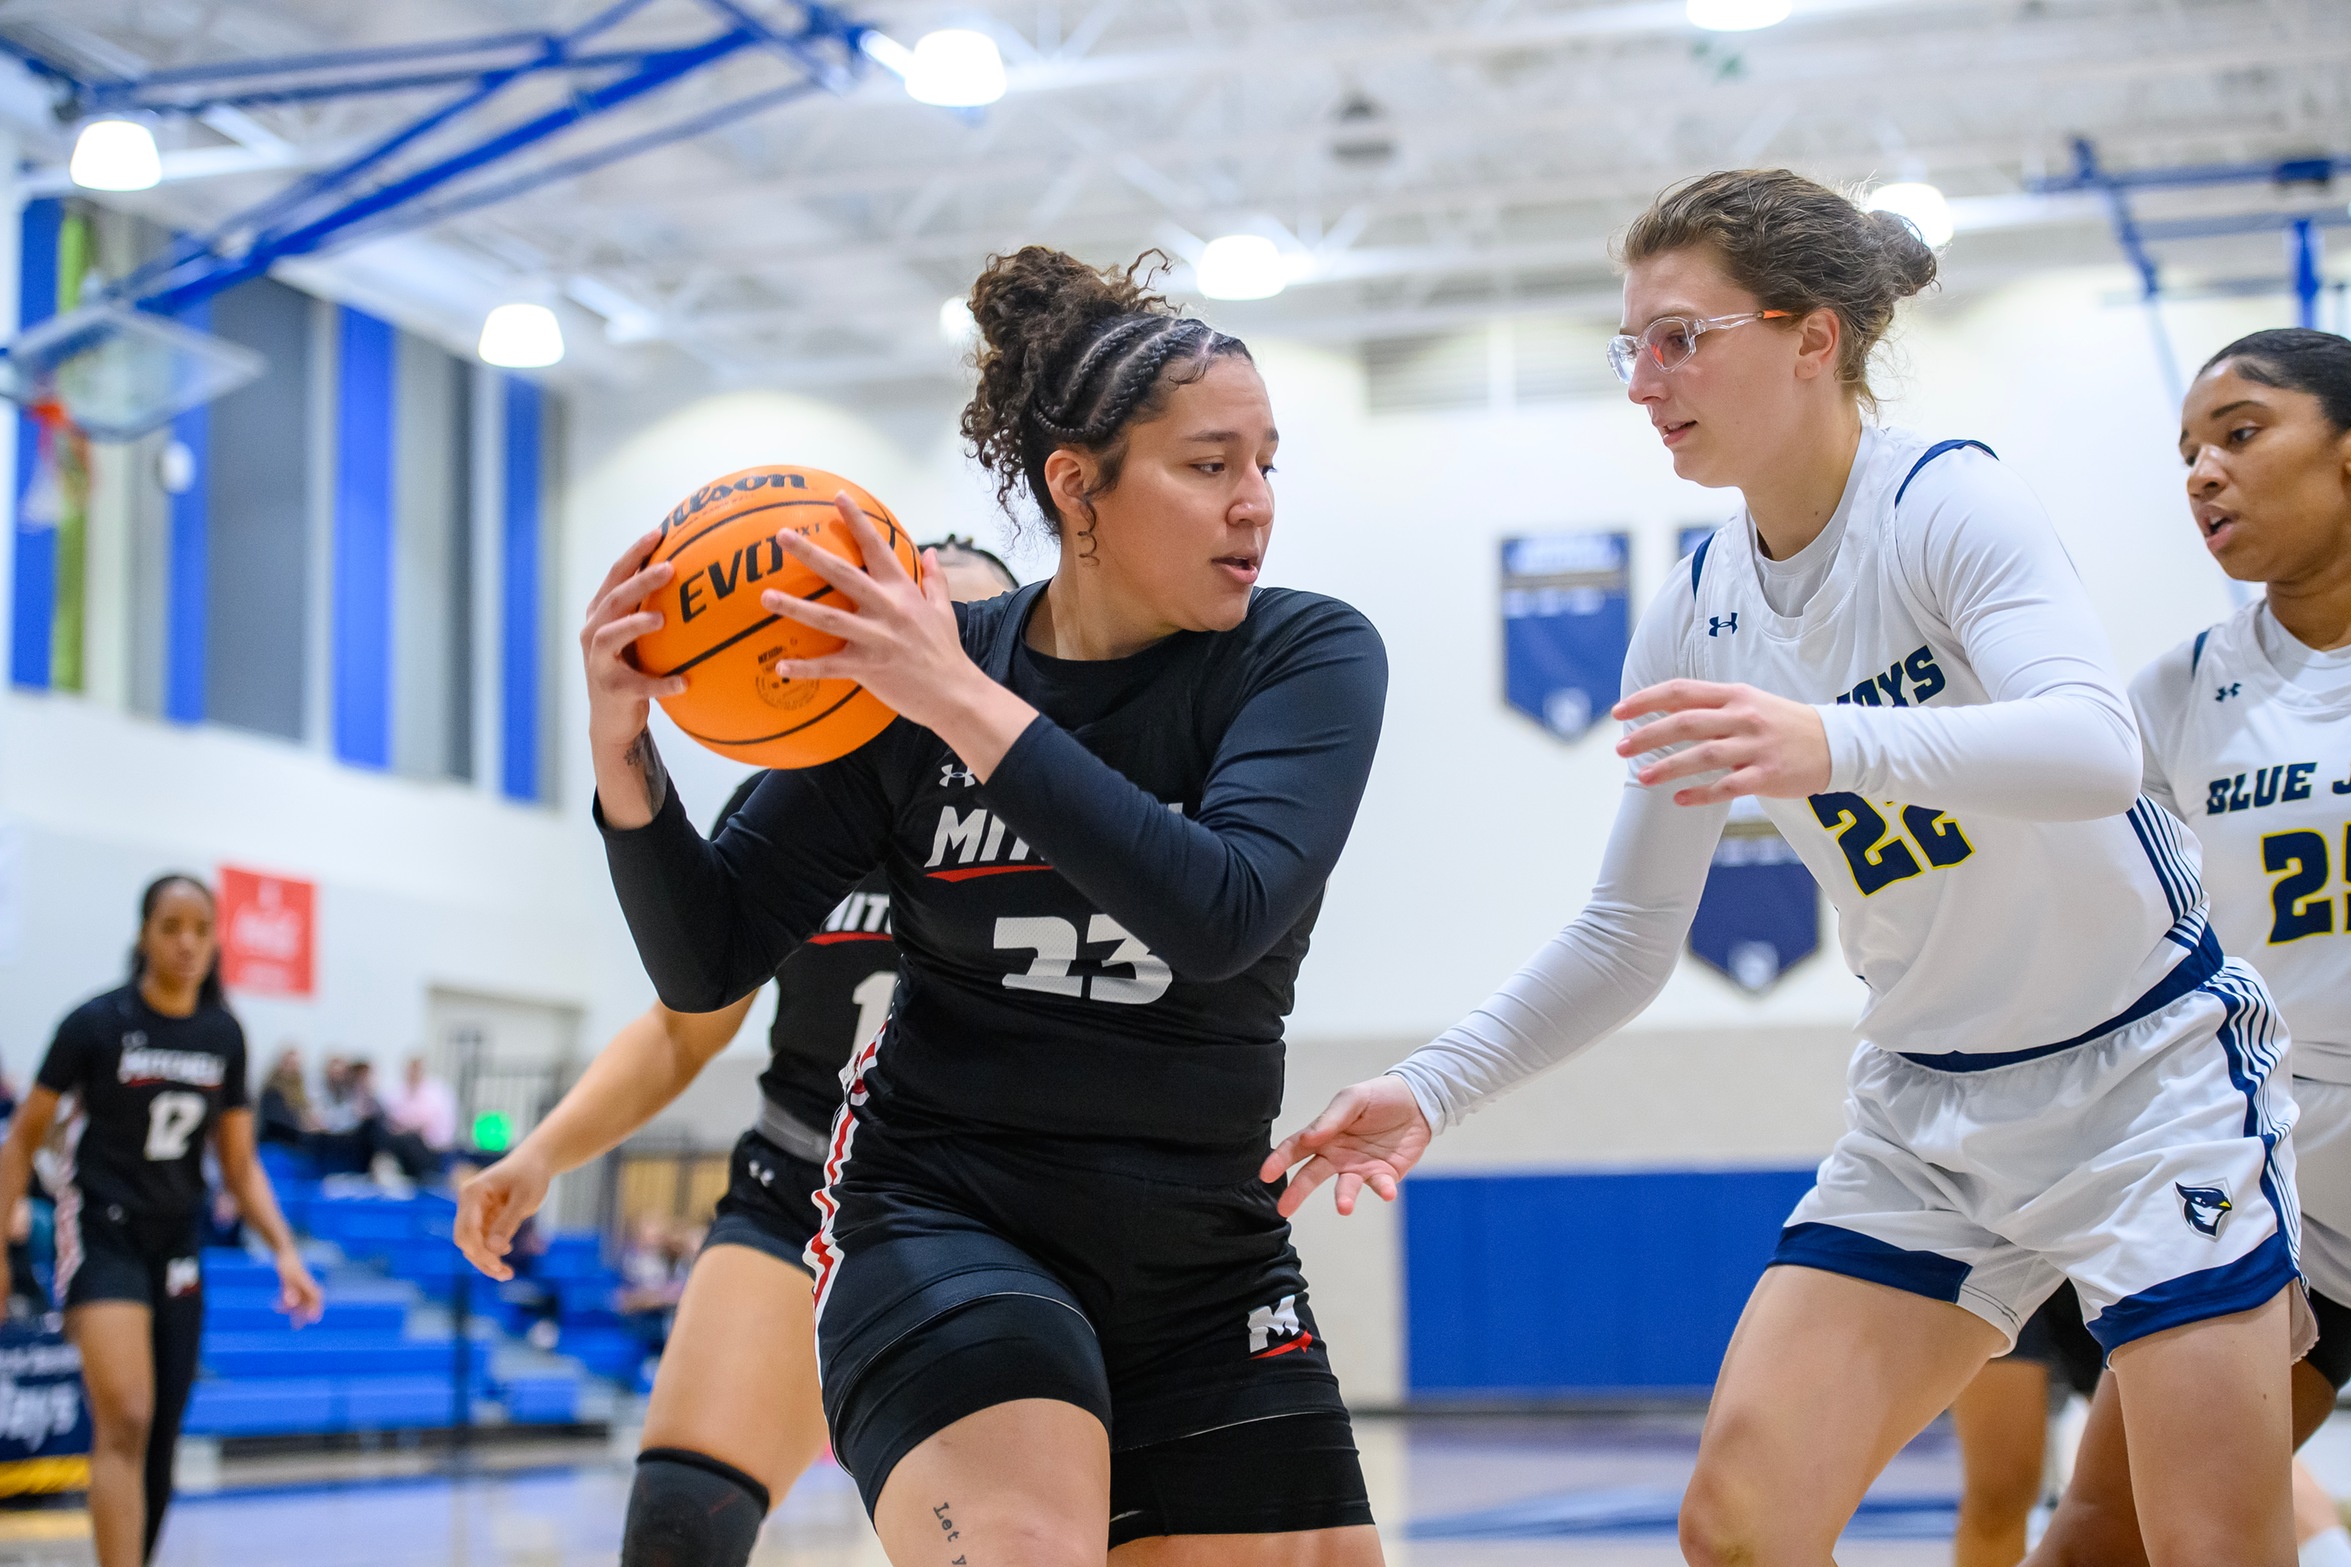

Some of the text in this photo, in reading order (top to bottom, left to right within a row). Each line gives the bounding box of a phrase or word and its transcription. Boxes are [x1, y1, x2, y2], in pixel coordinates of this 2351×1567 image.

[679, 534, 783, 624] EVO
[1836, 644, 1946, 708] AYS
[2206, 761, 2318, 816] BLUE
[993, 913, 1173, 1005] 23
[933, 1501, 960, 1543] Let
